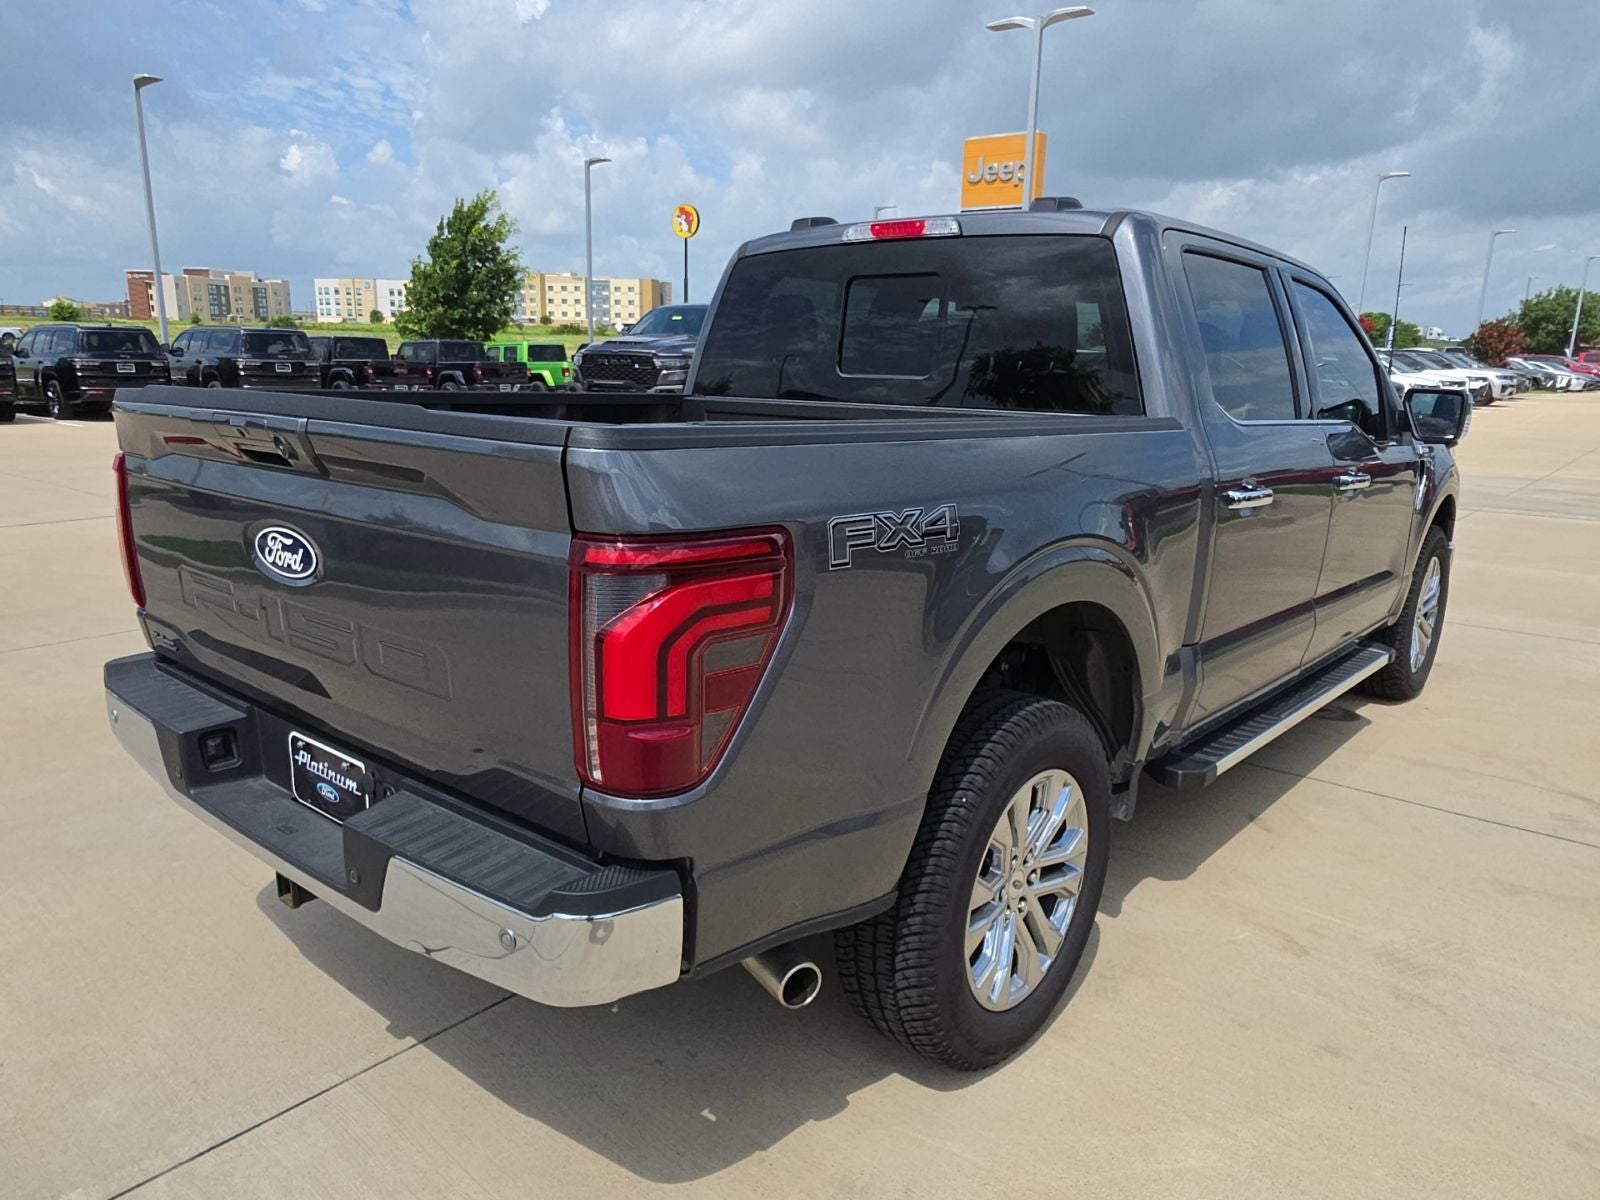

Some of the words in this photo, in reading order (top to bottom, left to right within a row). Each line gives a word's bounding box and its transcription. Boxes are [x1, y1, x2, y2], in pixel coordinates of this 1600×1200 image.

[967, 155, 1025, 187] Jeep
[264, 531, 305, 573] Ford
[827, 503, 961, 571] FX4
[178, 563, 453, 701] F-150
[294, 749, 362, 797] Platinum
